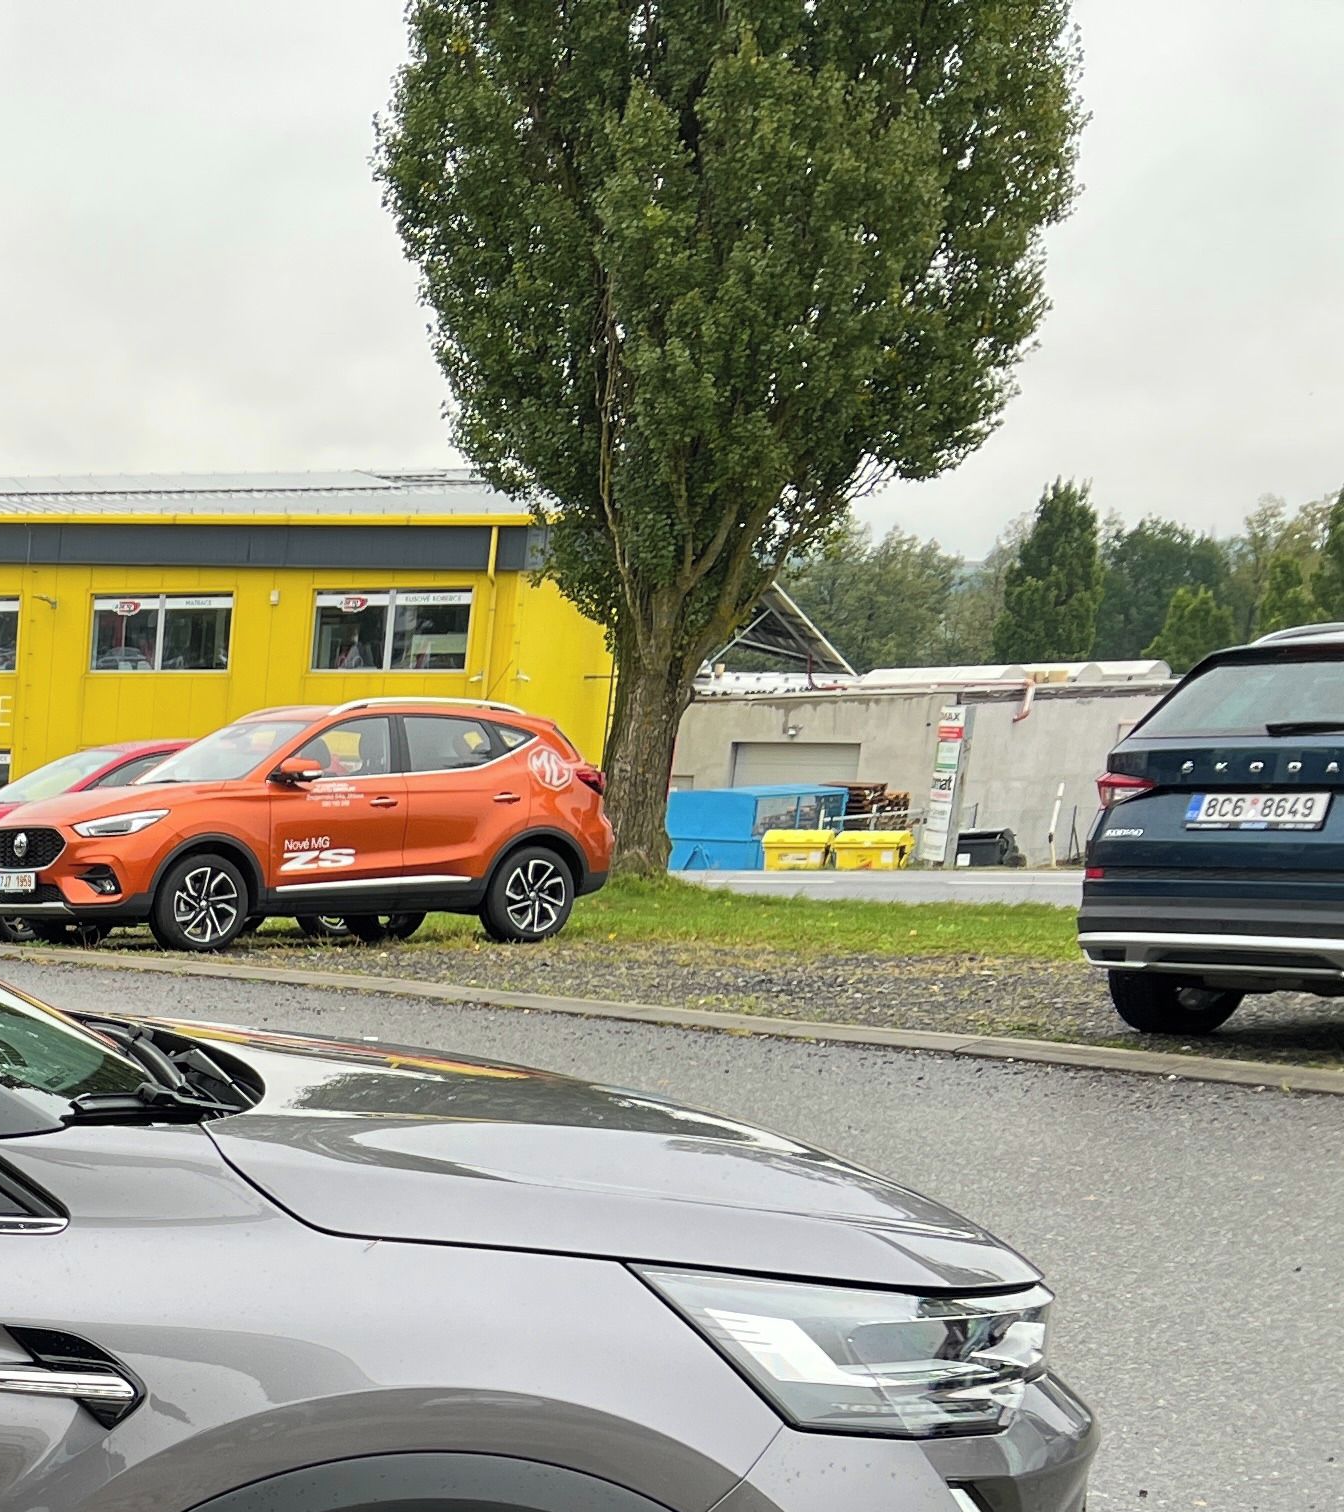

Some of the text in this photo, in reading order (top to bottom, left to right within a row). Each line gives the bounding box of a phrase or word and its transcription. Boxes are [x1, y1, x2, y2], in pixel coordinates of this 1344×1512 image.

[1204, 797, 1316, 818] 8C6 8649
[284, 836, 330, 851] Nové MG
[280, 848, 356, 871] ZS
